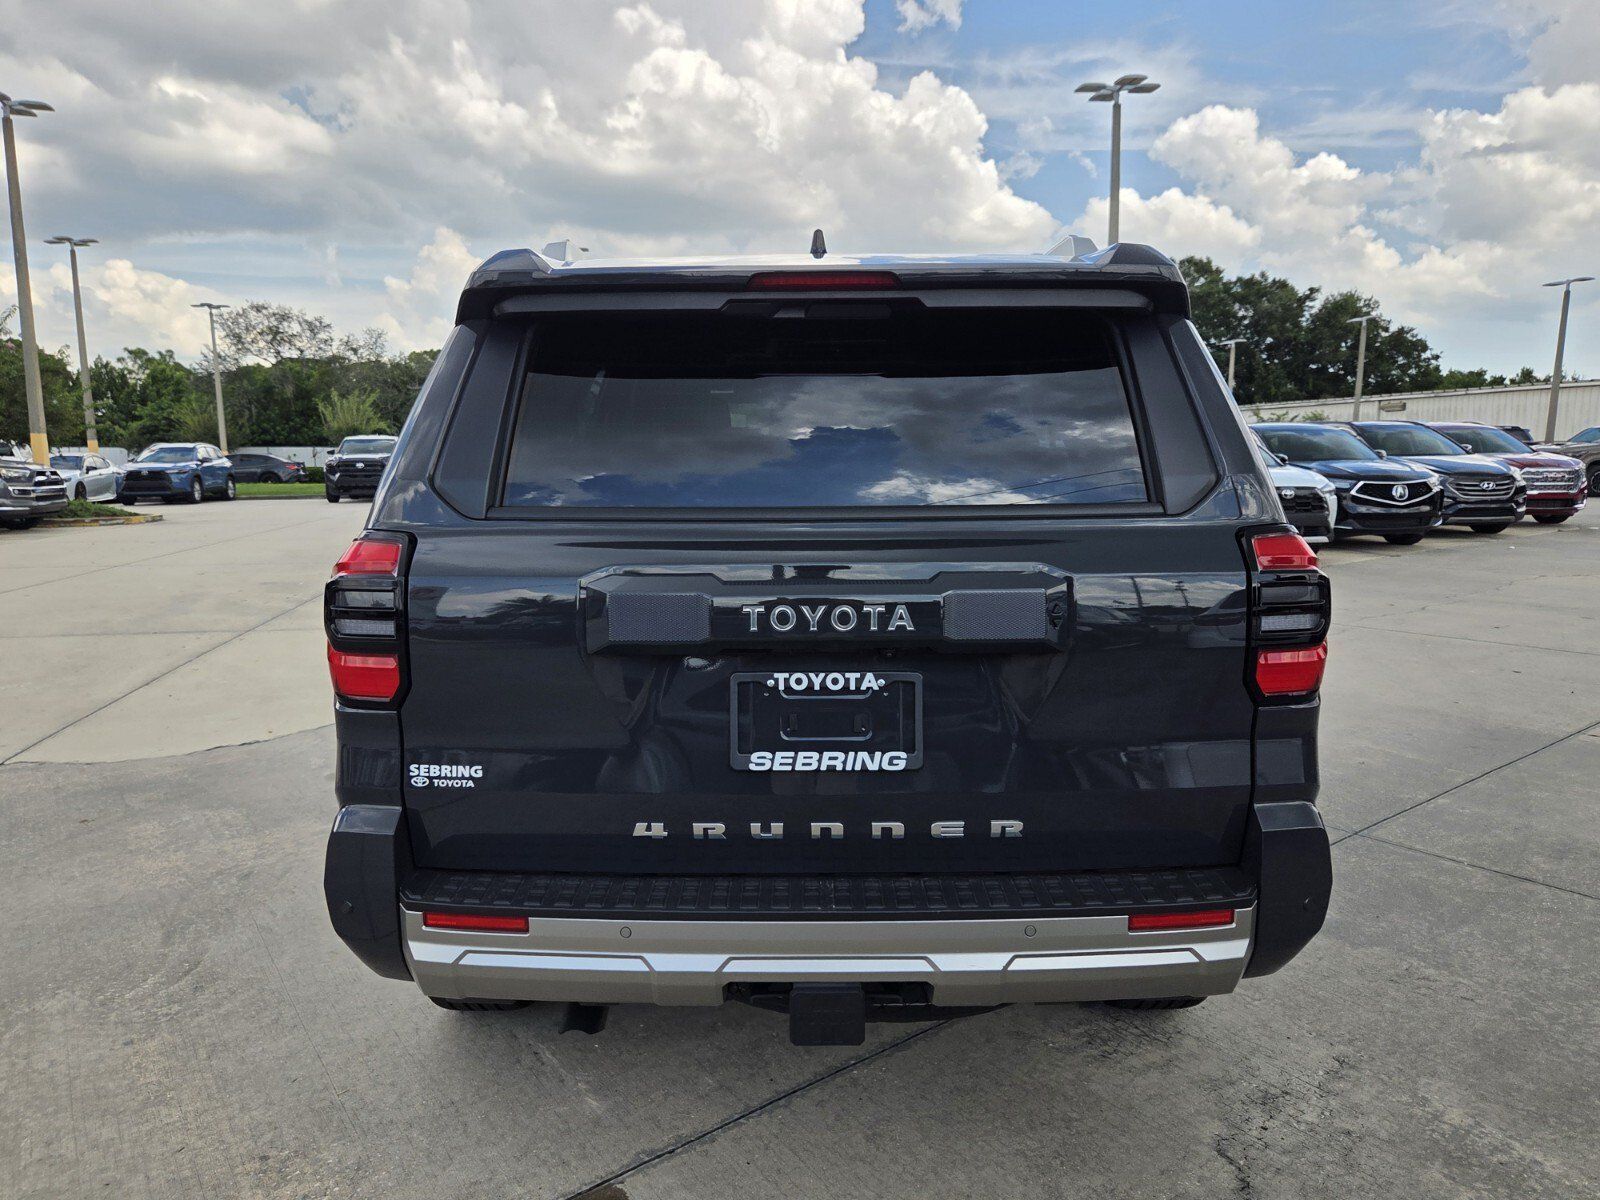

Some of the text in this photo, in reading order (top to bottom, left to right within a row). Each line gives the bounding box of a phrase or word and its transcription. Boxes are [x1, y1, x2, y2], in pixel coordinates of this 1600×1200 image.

[742, 604, 915, 631] TOYOTA
[773, 672, 880, 691] TOYOTA
[409, 764, 483, 777] SEBRING
[748, 751, 908, 771] SEBRING
[432, 779, 475, 787] TOYOTA
